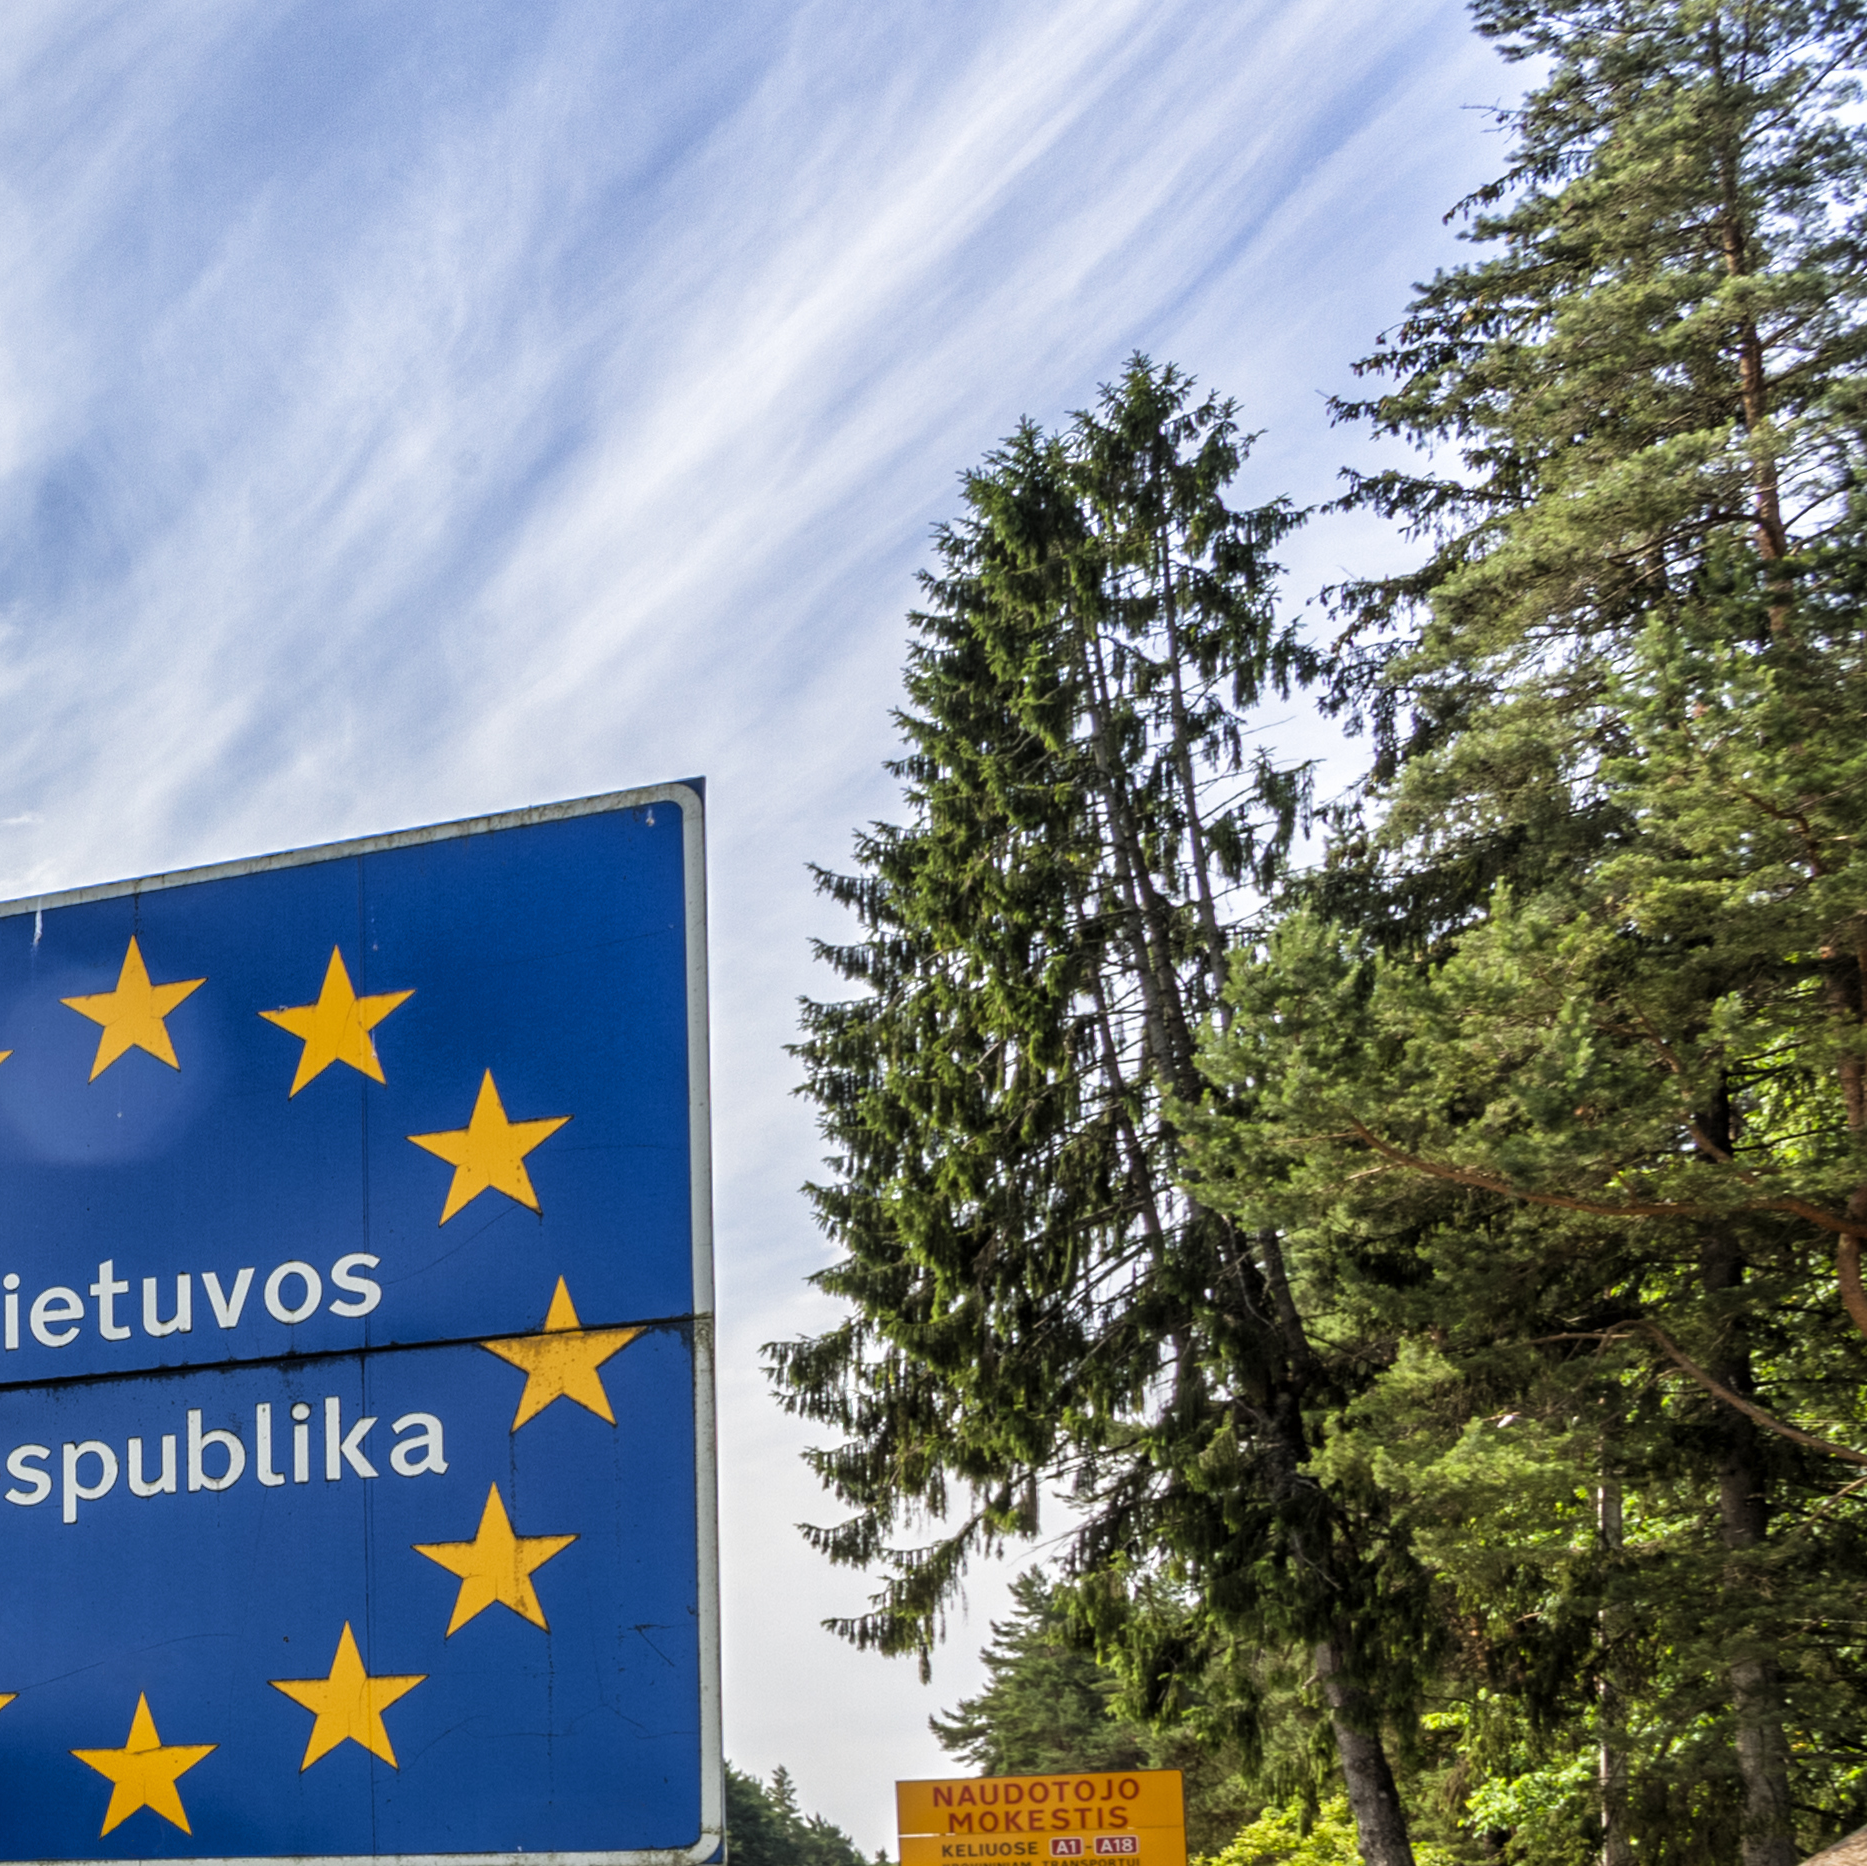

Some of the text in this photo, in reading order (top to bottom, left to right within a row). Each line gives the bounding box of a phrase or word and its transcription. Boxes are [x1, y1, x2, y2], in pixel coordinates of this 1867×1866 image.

[932, 1778, 1140, 1807] NAUDOTOJO
[948, 1806, 1129, 1833] MOKESTIS
[941, 1841, 1039, 1857] KELIUOSE
[1056, 1840, 1077, 1854] A1
[1100, 1838, 1133, 1853] A18
